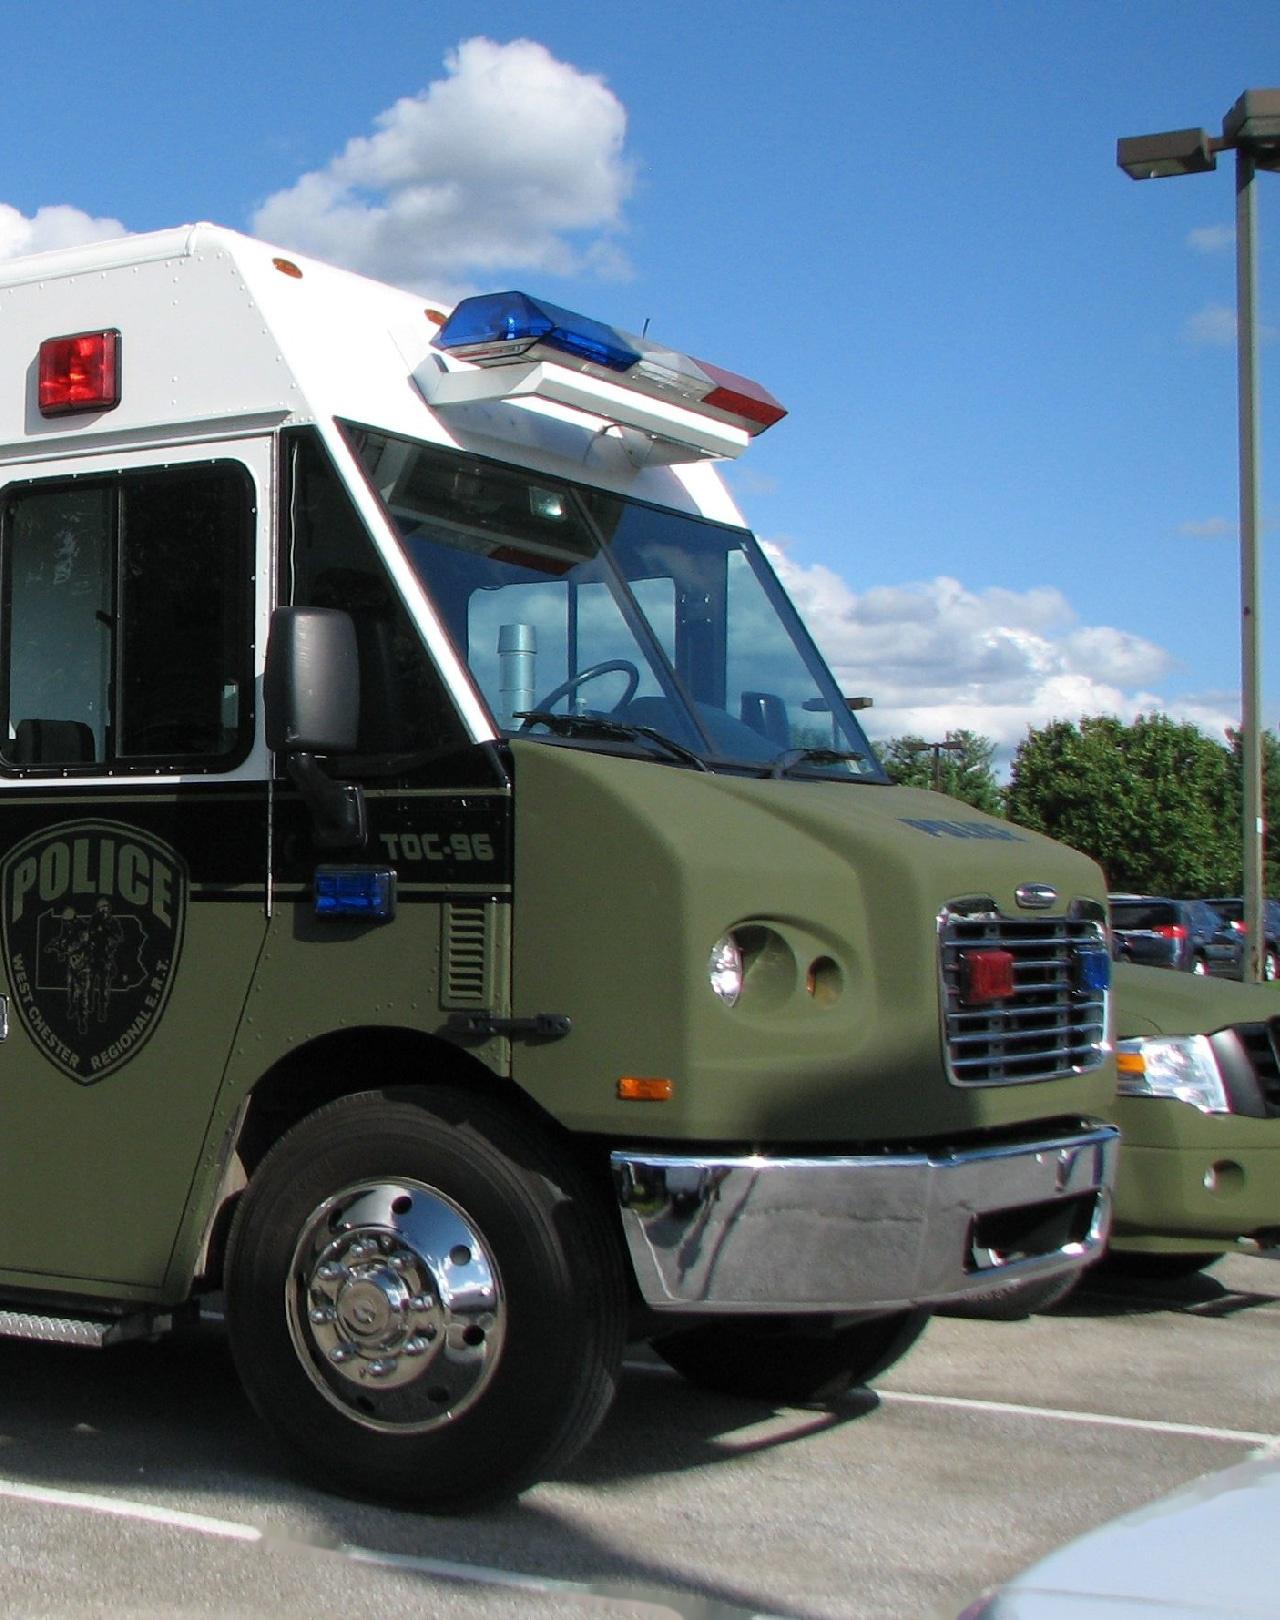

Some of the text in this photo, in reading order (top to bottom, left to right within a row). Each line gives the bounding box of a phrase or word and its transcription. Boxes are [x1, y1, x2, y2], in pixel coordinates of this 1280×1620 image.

[12, 838, 171, 930] POLICE
[379, 833, 495, 861] TOC-96
[12, 954, 80, 1068] WEST CHESTER
[90, 1010, 152, 1070] REGIONAL
